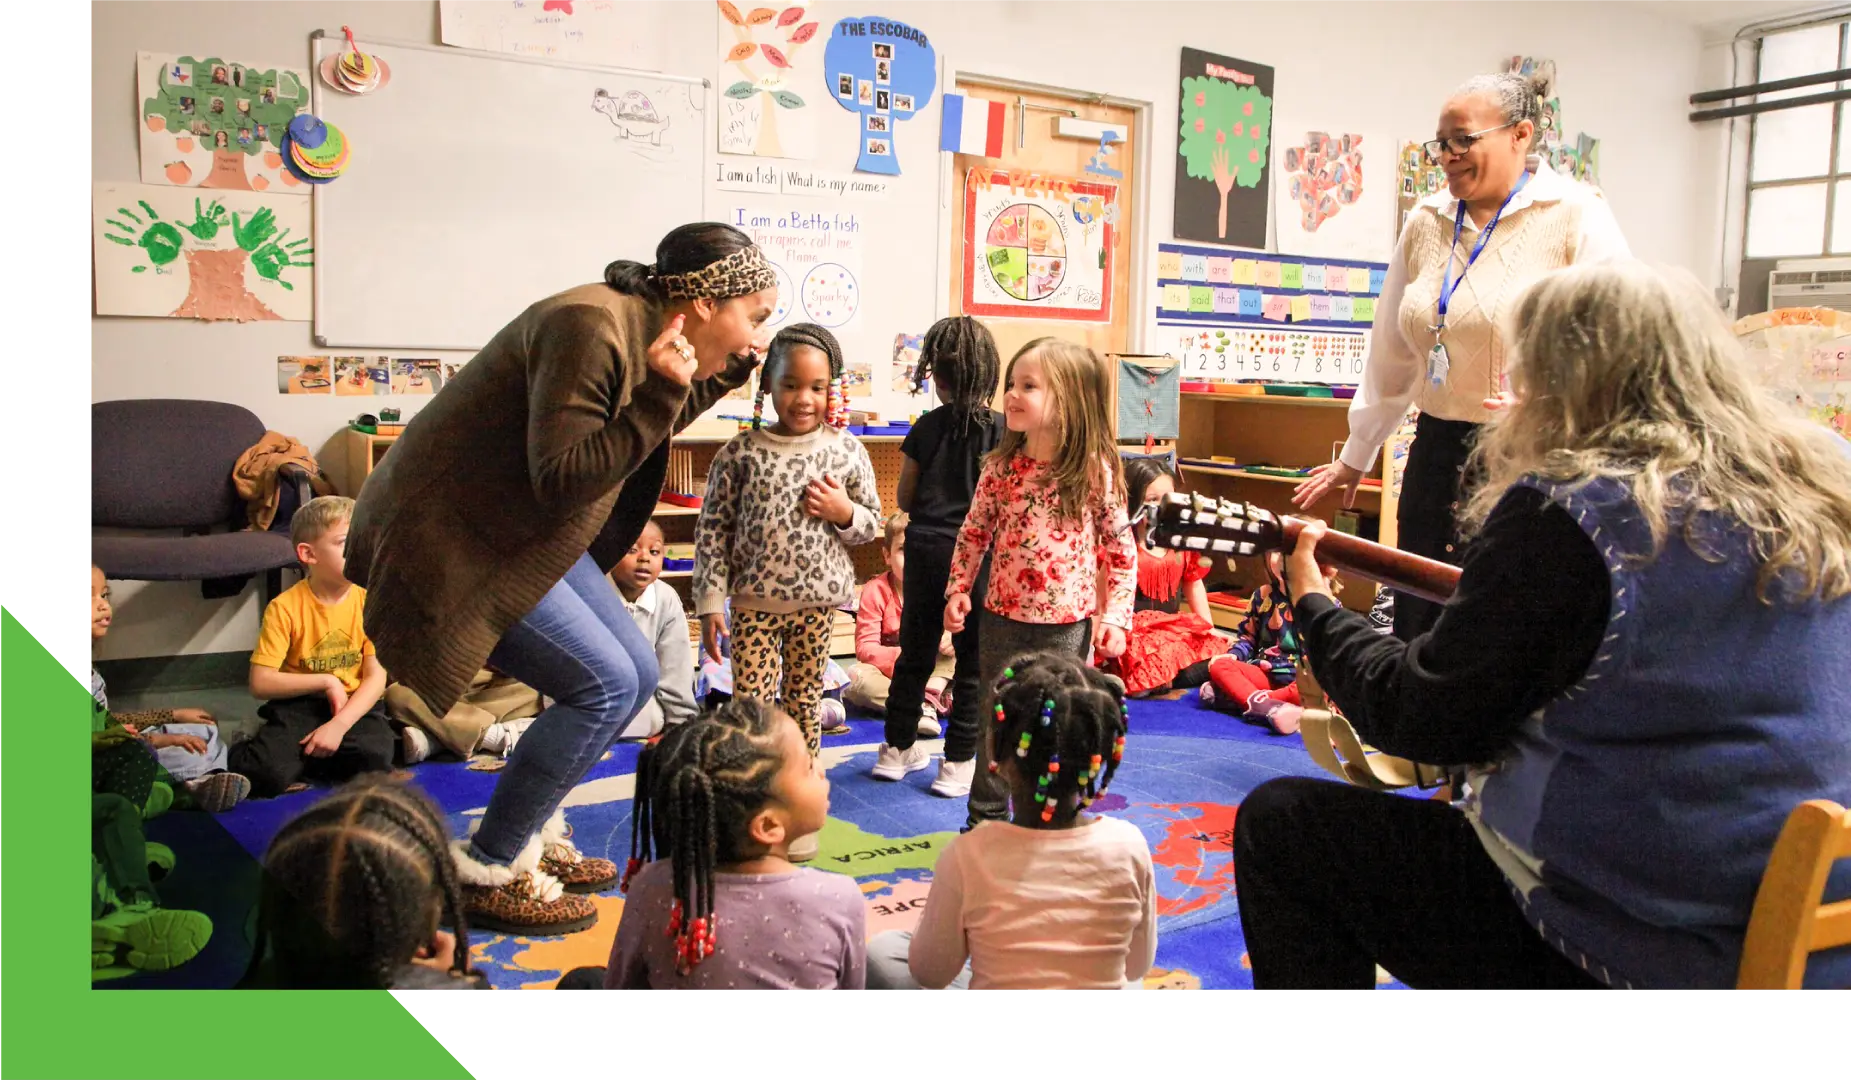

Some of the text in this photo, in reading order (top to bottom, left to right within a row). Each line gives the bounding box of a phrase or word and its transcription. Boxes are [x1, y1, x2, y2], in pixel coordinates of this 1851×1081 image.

[840, 22, 928, 48] THE ESCOBAR
[717, 163, 777, 184] I am a fish
[787, 170, 886, 196] What is my name?
[735, 208, 859, 232] I am a Betta fish
[810, 232, 831, 247] call
[837, 238, 853, 249] me
[786, 250, 818, 263] Flame
[1184, 263, 1204, 274] with
[1212, 267, 1227, 275] are
[1285, 271, 1299, 280] will
[811, 287, 850, 306] Sparky
[1191, 293, 1210, 305] said
[1217, 292, 1235, 304] that
[1243, 299, 1258, 308] out
[1310, 300, 1330, 310] them
[1335, 300, 1348, 312] like
[1199, 353, 1207, 370] 2
[1218, 354, 1226, 370] 3
[1236, 354, 1244, 371] 4
[1254, 355, 1261, 371] 5
[1272, 356, 1280, 371] 6
[1294, 357, 1301, 372] 7
[1315, 357, 1322, 373] 8
[1334, 358, 1341, 373] 9
[1350, 359, 1363, 374] 10
[831, 841, 932, 863] AFRICA
